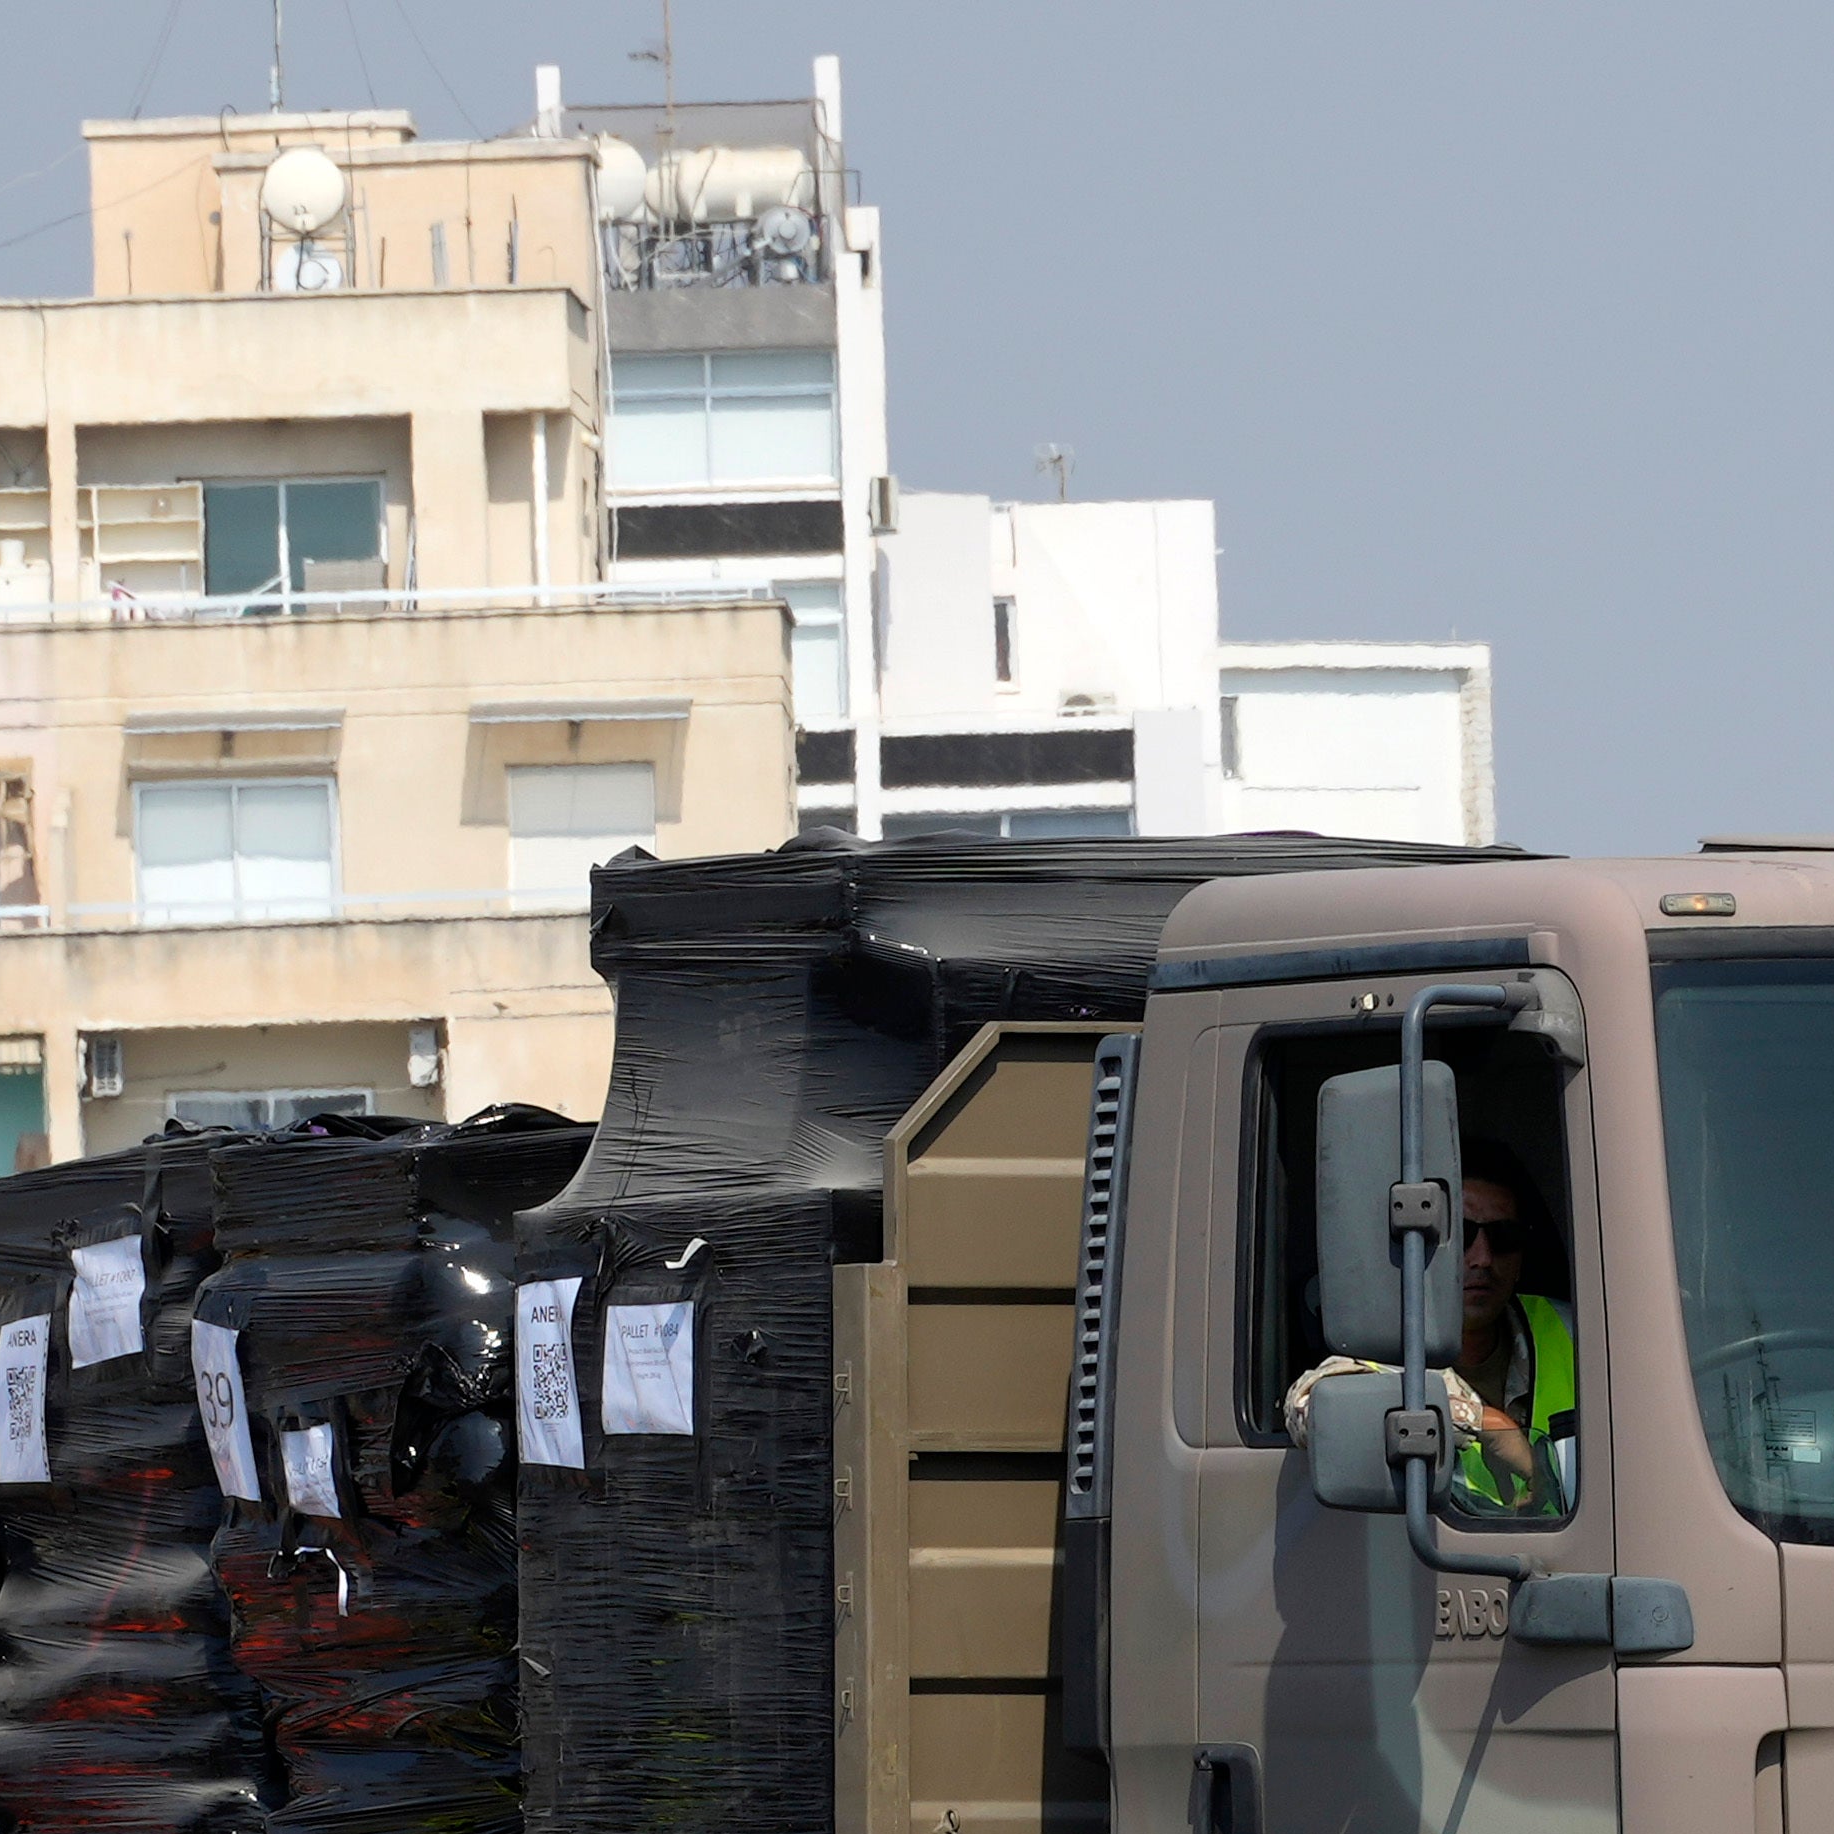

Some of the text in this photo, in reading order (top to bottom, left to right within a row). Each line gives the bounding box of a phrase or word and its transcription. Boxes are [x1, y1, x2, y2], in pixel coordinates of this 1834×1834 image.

[7, 1329, 37, 1346] ANERA
[621, 1323, 649, 1339] PALLET
[200, 1370, 235, 1430] 39
